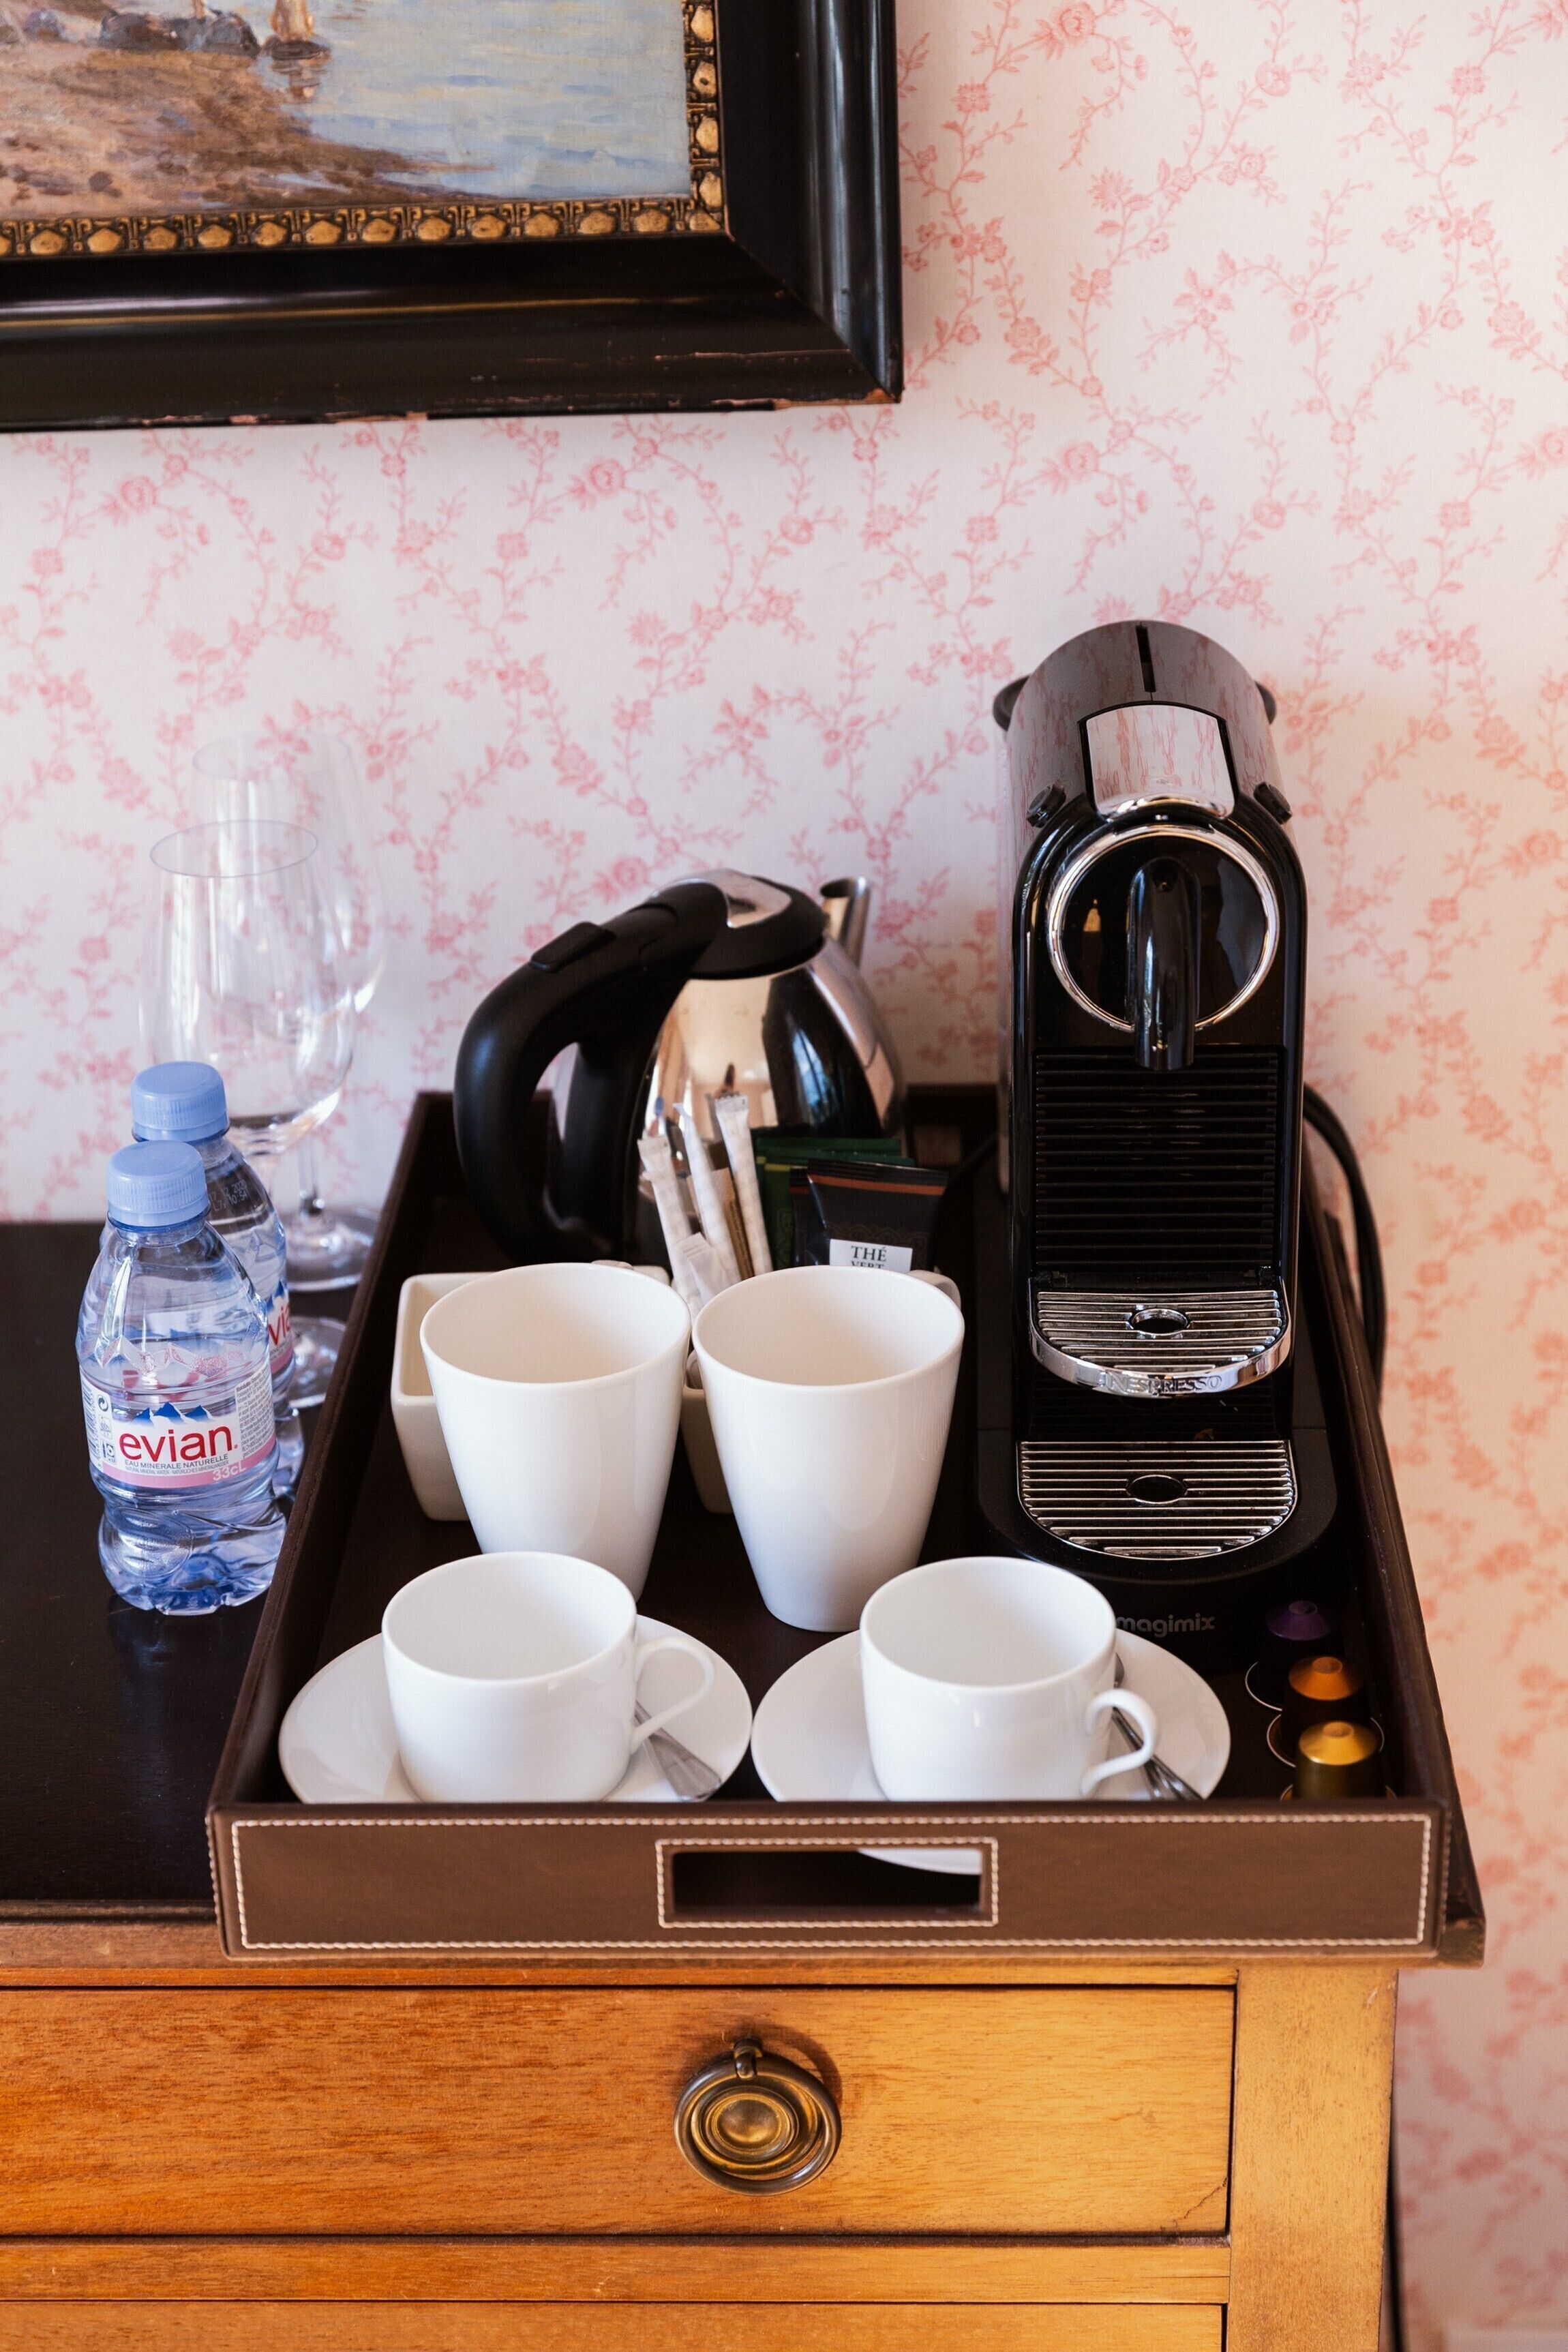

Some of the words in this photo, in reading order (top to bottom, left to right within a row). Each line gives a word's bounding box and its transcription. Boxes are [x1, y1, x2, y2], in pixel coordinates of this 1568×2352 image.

[850, 1245, 887, 1262] THÉ
[119, 1426, 232, 1462] evian
[125, 1459, 139, 1467] EAU
[140, 1462, 181, 1470] MINERALE
[183, 1453, 229, 1468] NATURELLE
[1116, 1613, 1215, 1638] magimix
